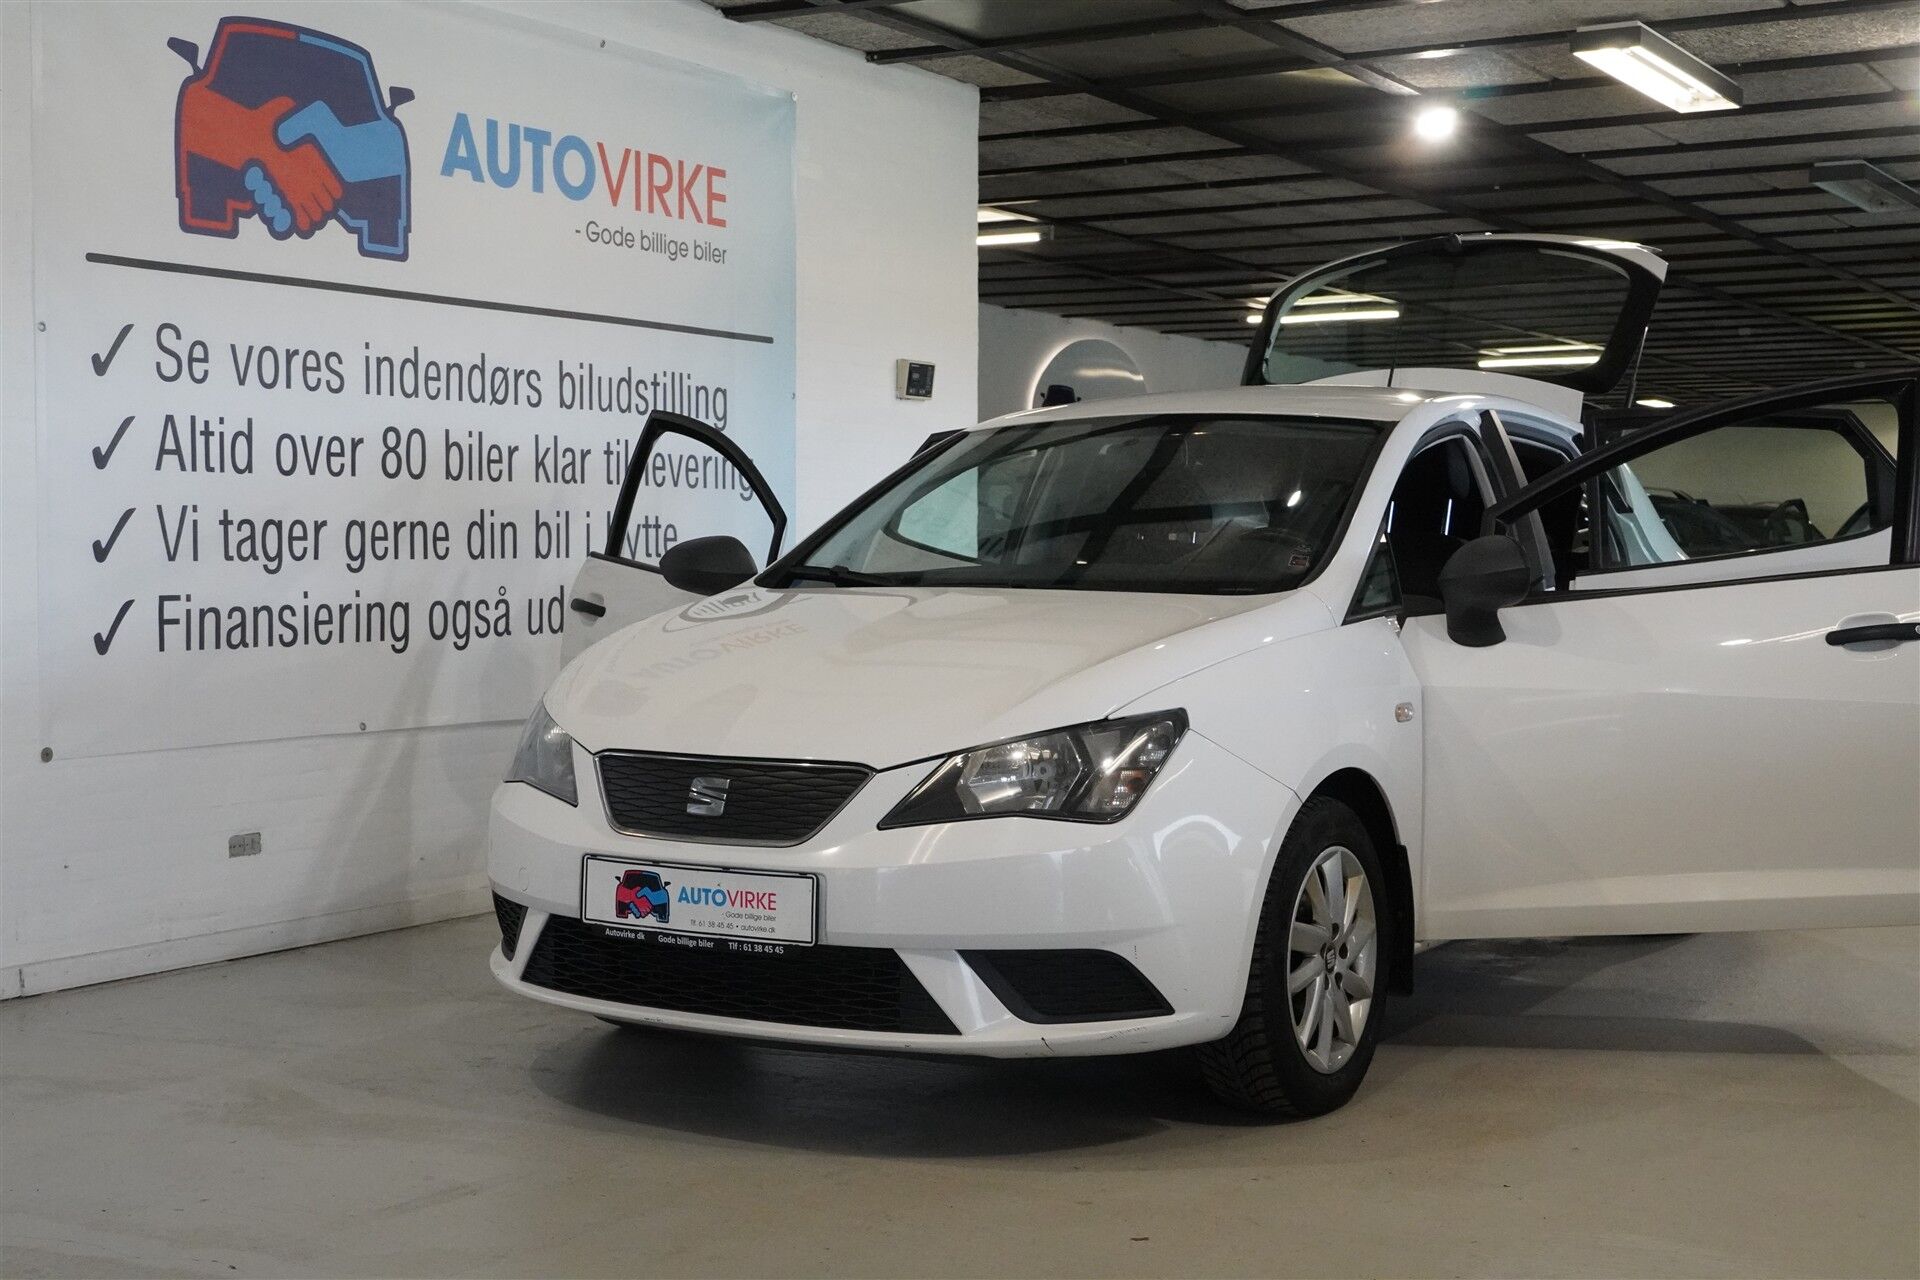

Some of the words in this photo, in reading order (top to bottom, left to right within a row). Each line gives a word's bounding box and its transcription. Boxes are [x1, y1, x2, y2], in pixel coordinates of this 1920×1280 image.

[440, 112, 727, 228] AUTOVIRKE
[586, 220, 635, 249] Gode
[640, 229, 689, 261] billige
[693, 239, 727, 264] biler
[156, 323, 210, 384] Se
[230, 343, 345, 394] vores
[364, 342, 542, 409] indendørs
[558, 360, 728, 432] biludstilling
[155, 414, 253, 475] Altid
[275, 432, 364, 477] over
[381, 426, 427, 480] 80
[445, 429, 519, 482] biler
[534, 434, 591, 484] klar
[156, 504, 199, 562] Vi
[218, 509, 328, 575] tager
[345, 519, 450, 574] gerne
[466, 508, 518, 561] din
[535, 509, 570, 560] bil
[586, 511, 591, 556] i
[157, 589, 410, 655] Finansiering
[428, 585, 512, 651] også
[678, 886, 777, 911] AUTOVIRKE
[698, 920, 706, 928] 61
[717, 922, 725, 930] 45
[725, 911, 743, 919] Gode
[658, 934, 676, 944] Gode
[677, 936, 697, 948] billige
[698, 939, 714, 948] biler
[743, 943, 752, 951] 61
[753, 944, 763, 952] 38
[763, 945, 774, 953] 45
[774, 946, 784, 954] 45
